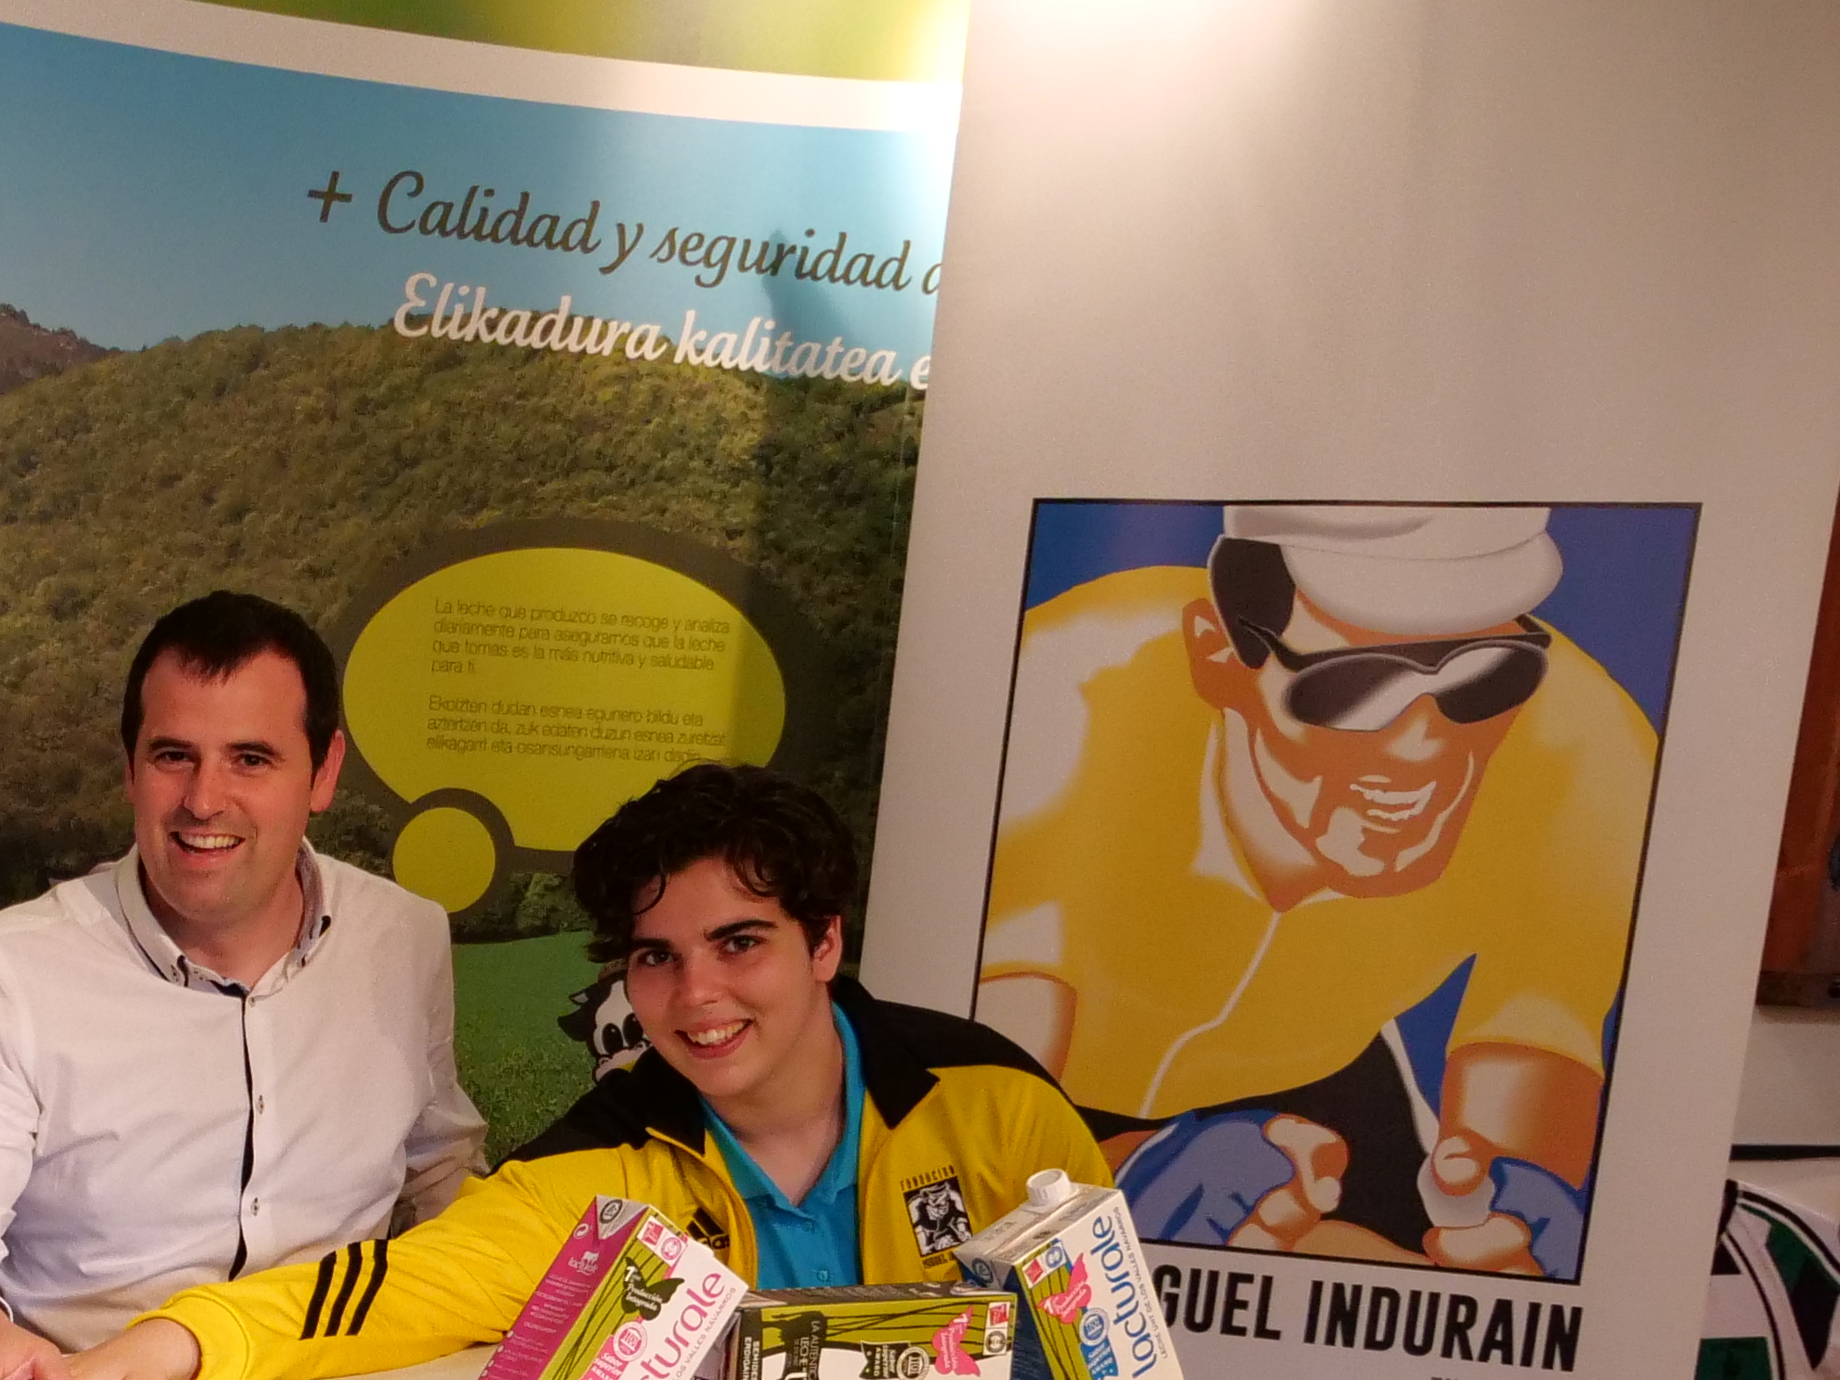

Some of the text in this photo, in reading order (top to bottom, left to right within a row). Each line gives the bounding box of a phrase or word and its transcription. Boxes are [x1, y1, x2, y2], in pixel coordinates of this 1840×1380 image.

[306, 170, 353, 222] +
[377, 170, 601, 254] Calidad
[599, 221, 644, 274] y
[650, 226, 910, 292] seguridad
[393, 271, 900, 388] Elikadura kalitatea
[1090, 1214, 1158, 1379] lacturale
[1303, 1279, 1584, 1373] INDURAIN
